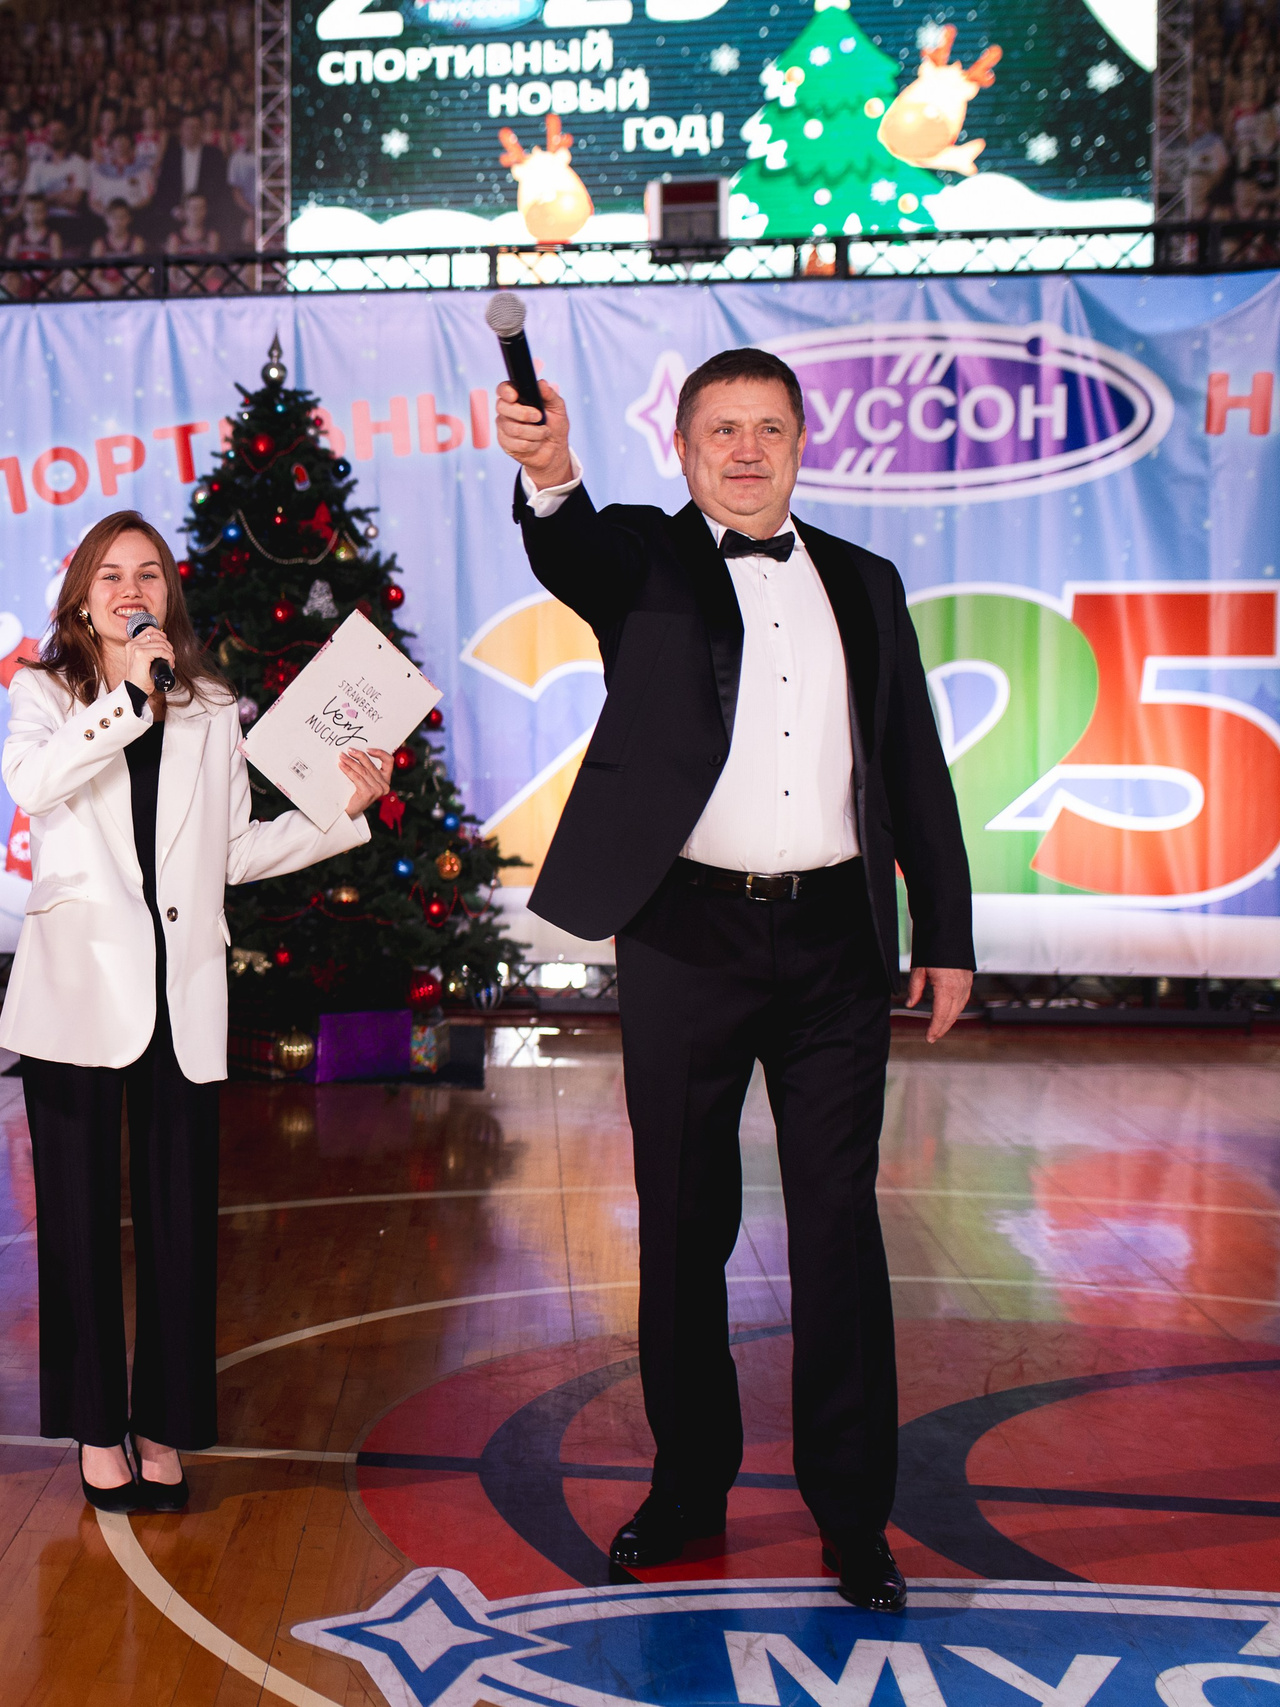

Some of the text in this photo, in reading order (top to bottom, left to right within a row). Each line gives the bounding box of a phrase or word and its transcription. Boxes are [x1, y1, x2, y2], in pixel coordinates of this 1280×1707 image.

[318, 29, 613, 85] СПОРТИВНЫЙ
[488, 69, 649, 117] НОВЫЙ
[623, 112, 724, 157] ГОД!
[806, 384, 1068, 445] УССОН
[338, 680, 384, 723] STRAWBERRY
[355, 676, 382, 703] I LOVE
[305, 714, 338, 746] MUCH
[323, 695, 368, 746] Very
